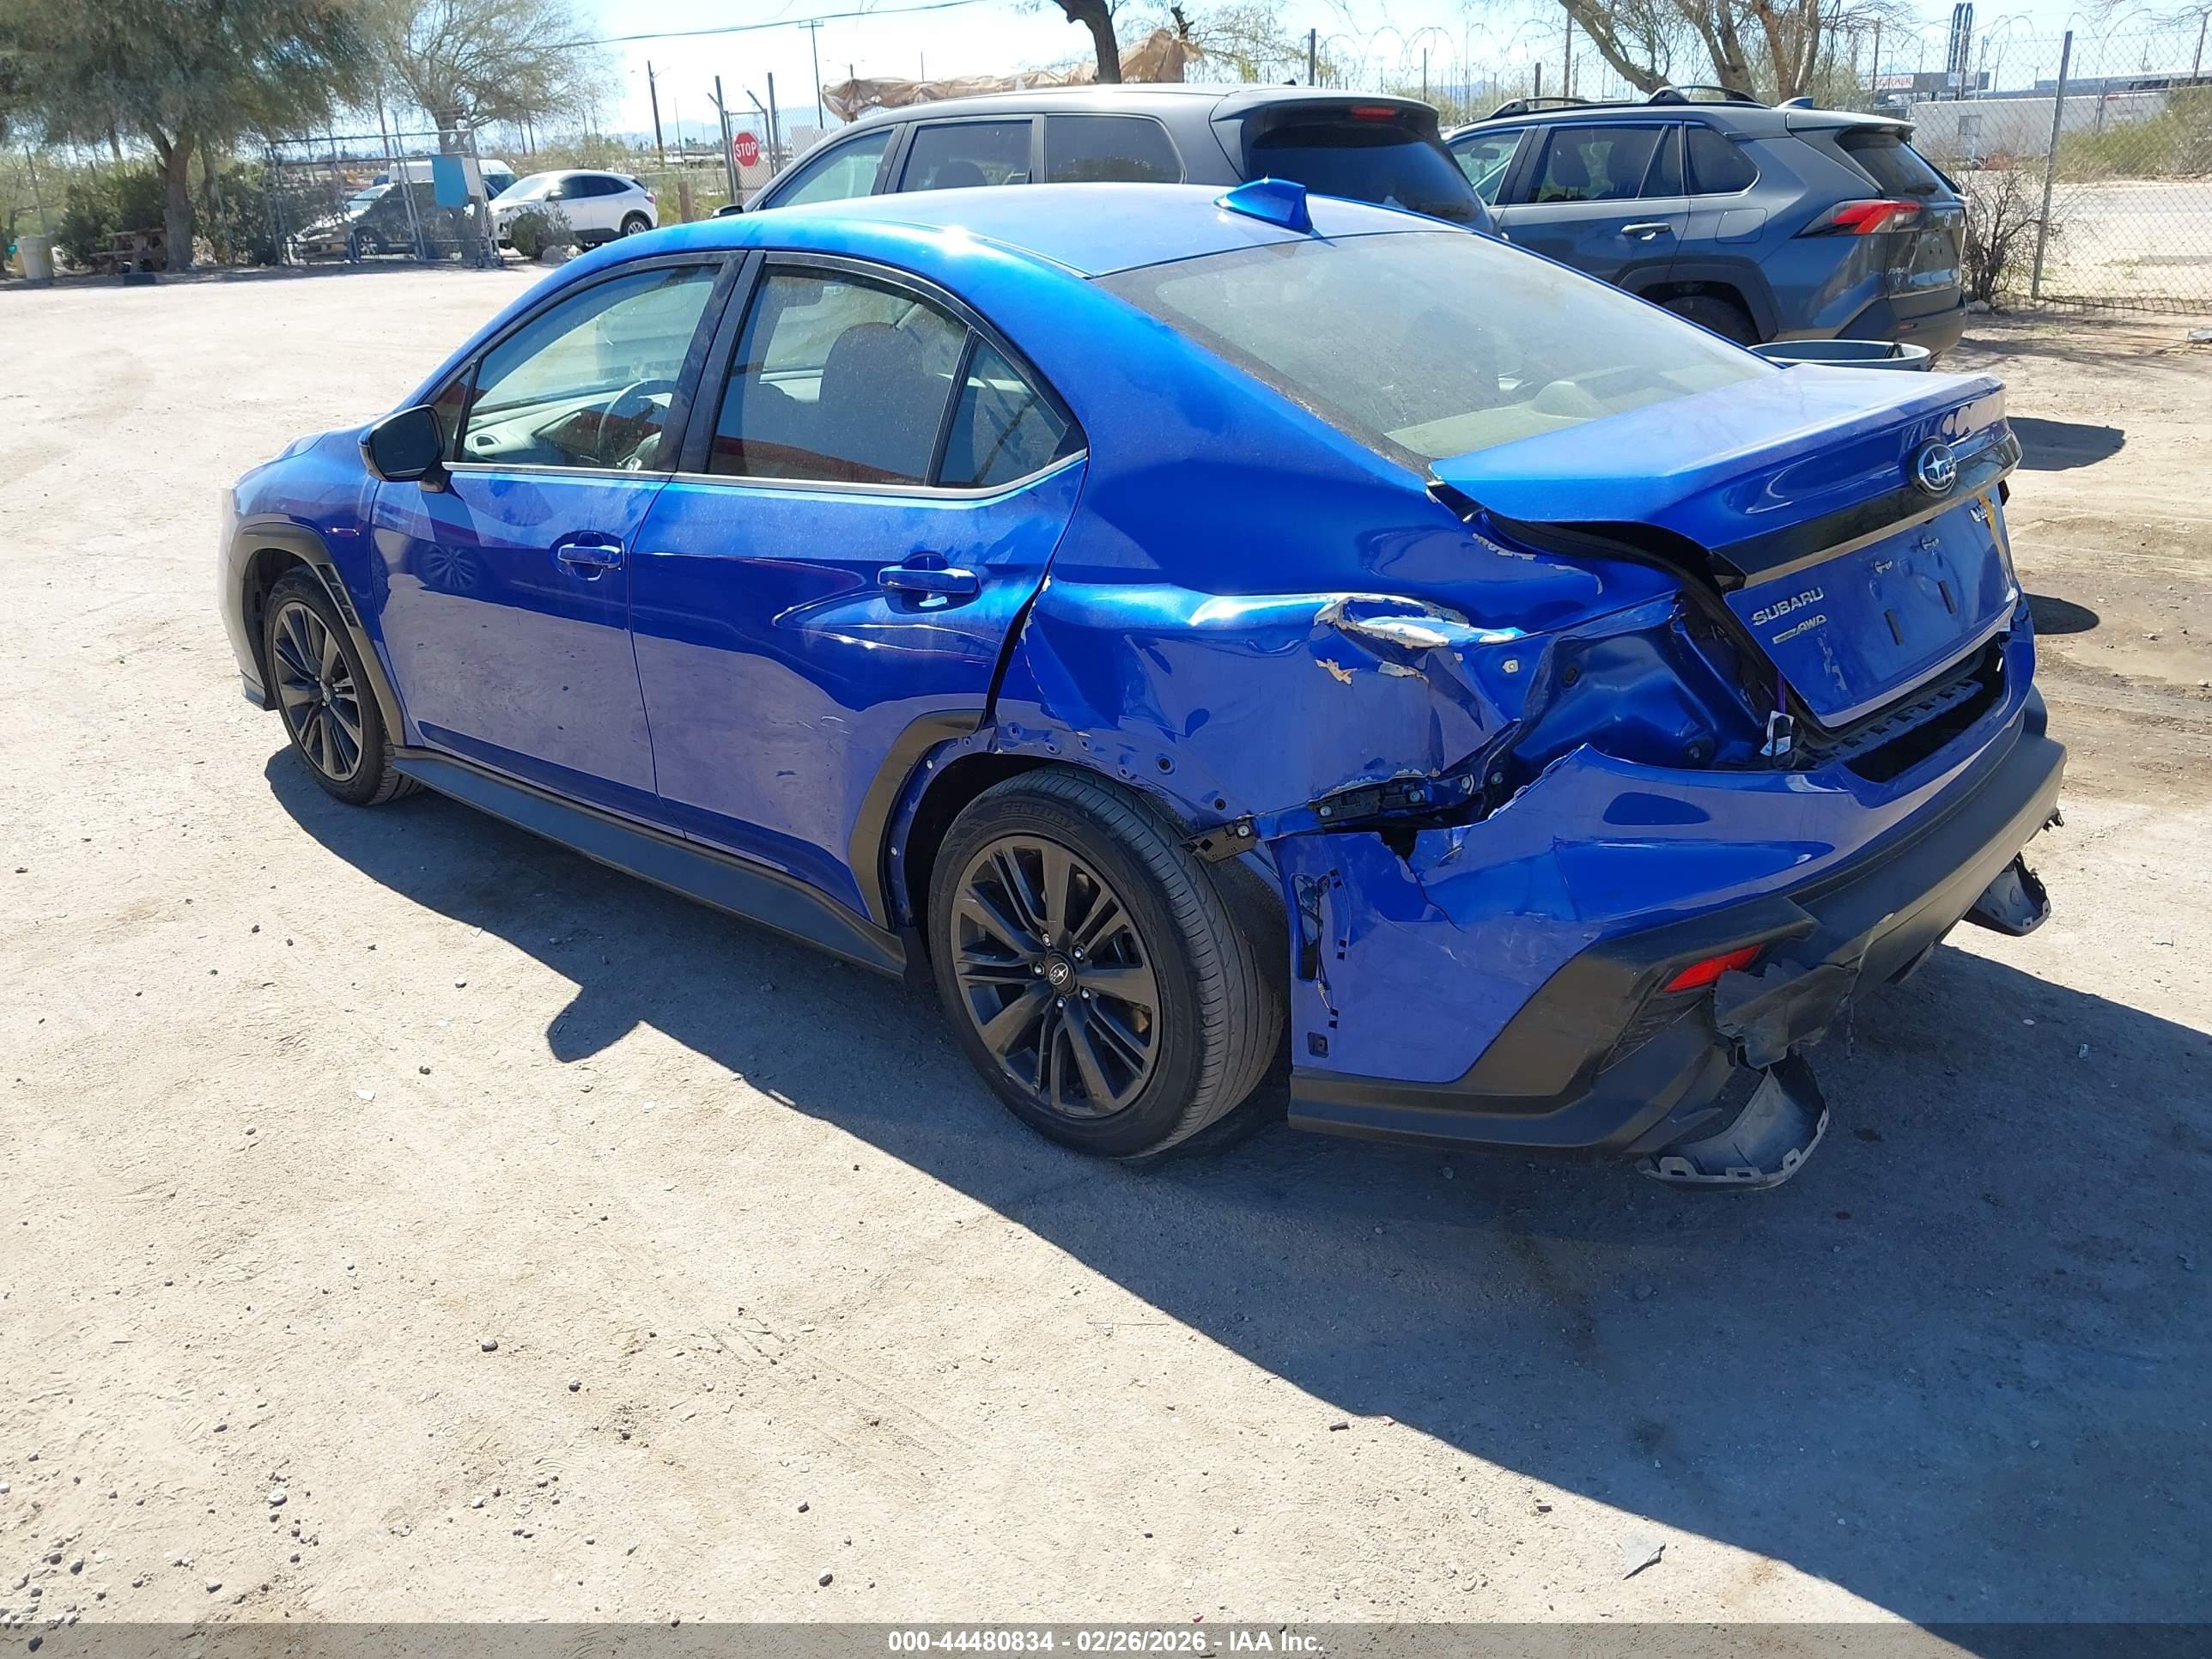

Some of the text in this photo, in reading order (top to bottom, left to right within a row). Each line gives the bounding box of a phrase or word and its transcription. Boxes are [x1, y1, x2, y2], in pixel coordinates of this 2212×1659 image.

[736, 142, 756, 157] STOP
[1752, 587, 1824, 625] SUBARU
[1796, 614, 1827, 635] AWD
